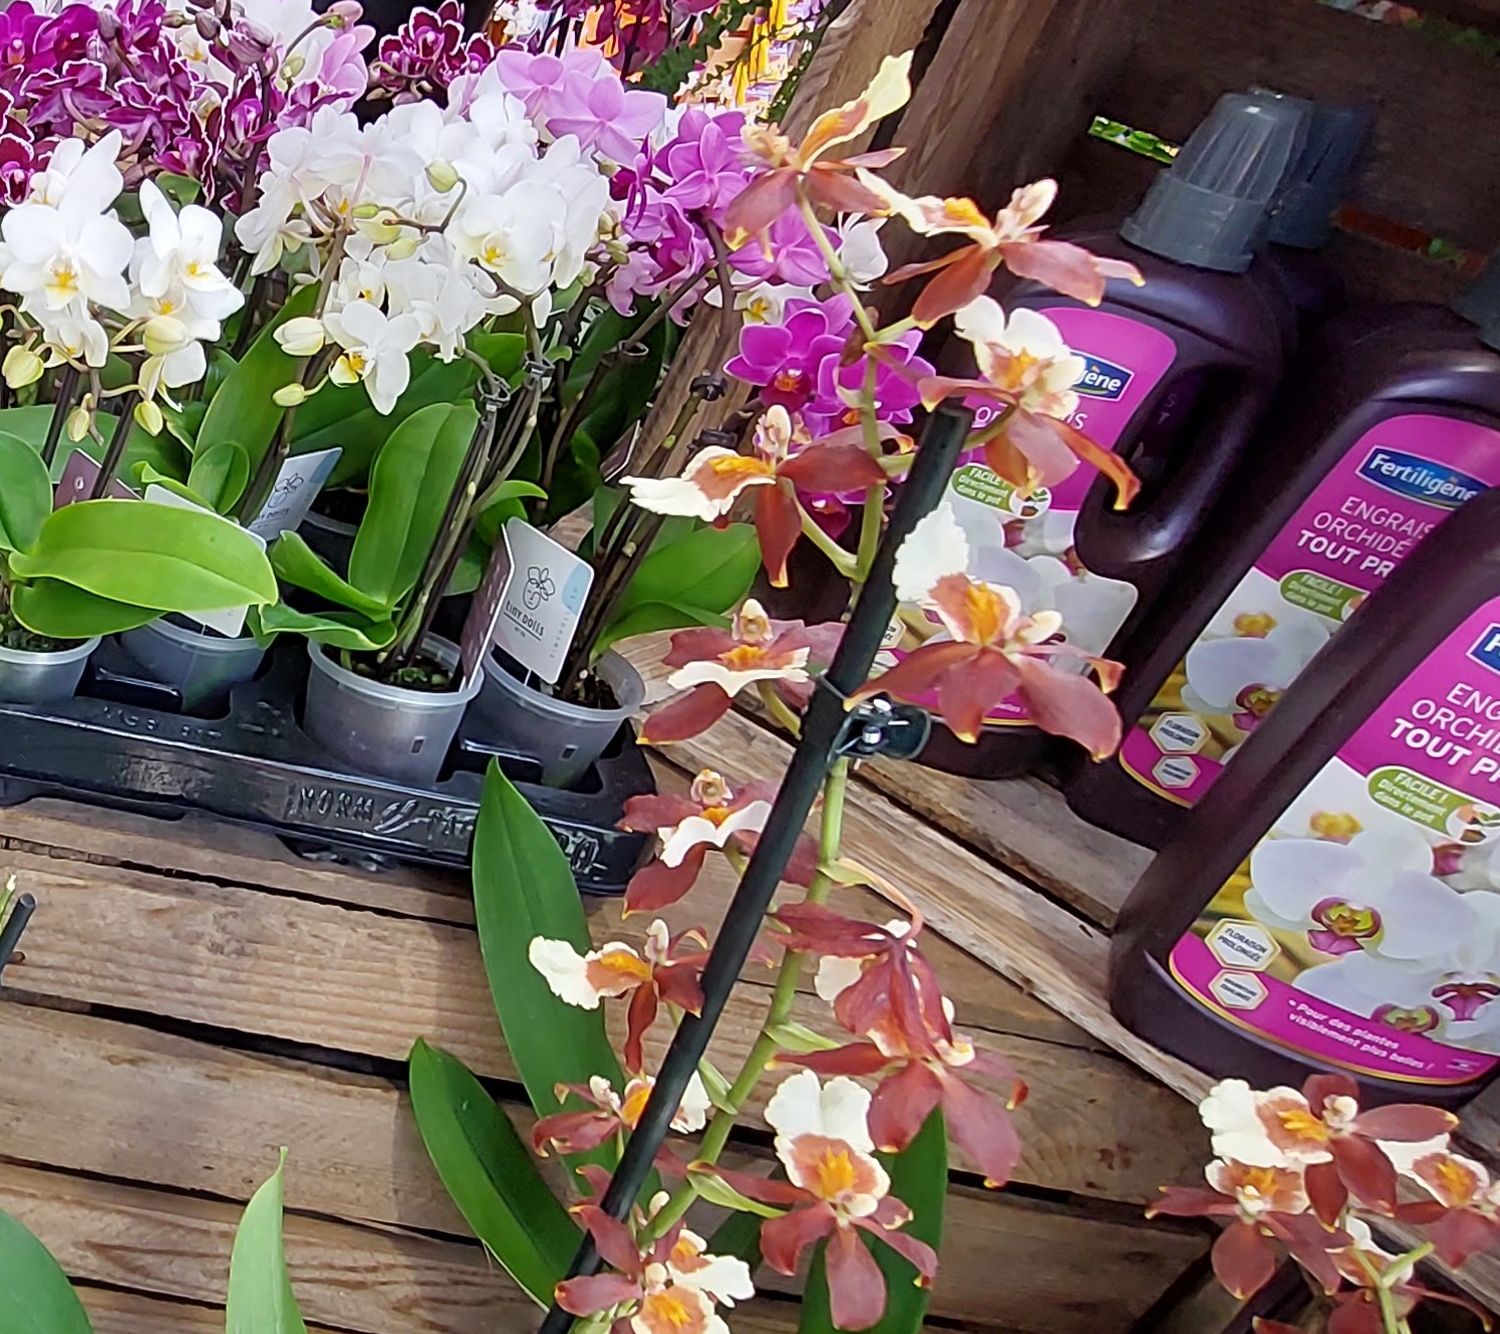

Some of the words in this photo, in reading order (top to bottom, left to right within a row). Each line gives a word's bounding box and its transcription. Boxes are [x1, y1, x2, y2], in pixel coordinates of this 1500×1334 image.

[1297, 529, 1361, 565] TOUT
[1359, 555, 1396, 578] PR
[1313, 512, 1414, 558] ORCHIDÉ
[1390, 717, 1472, 766] TOUT
[1394, 772, 1442, 800] FACILE
